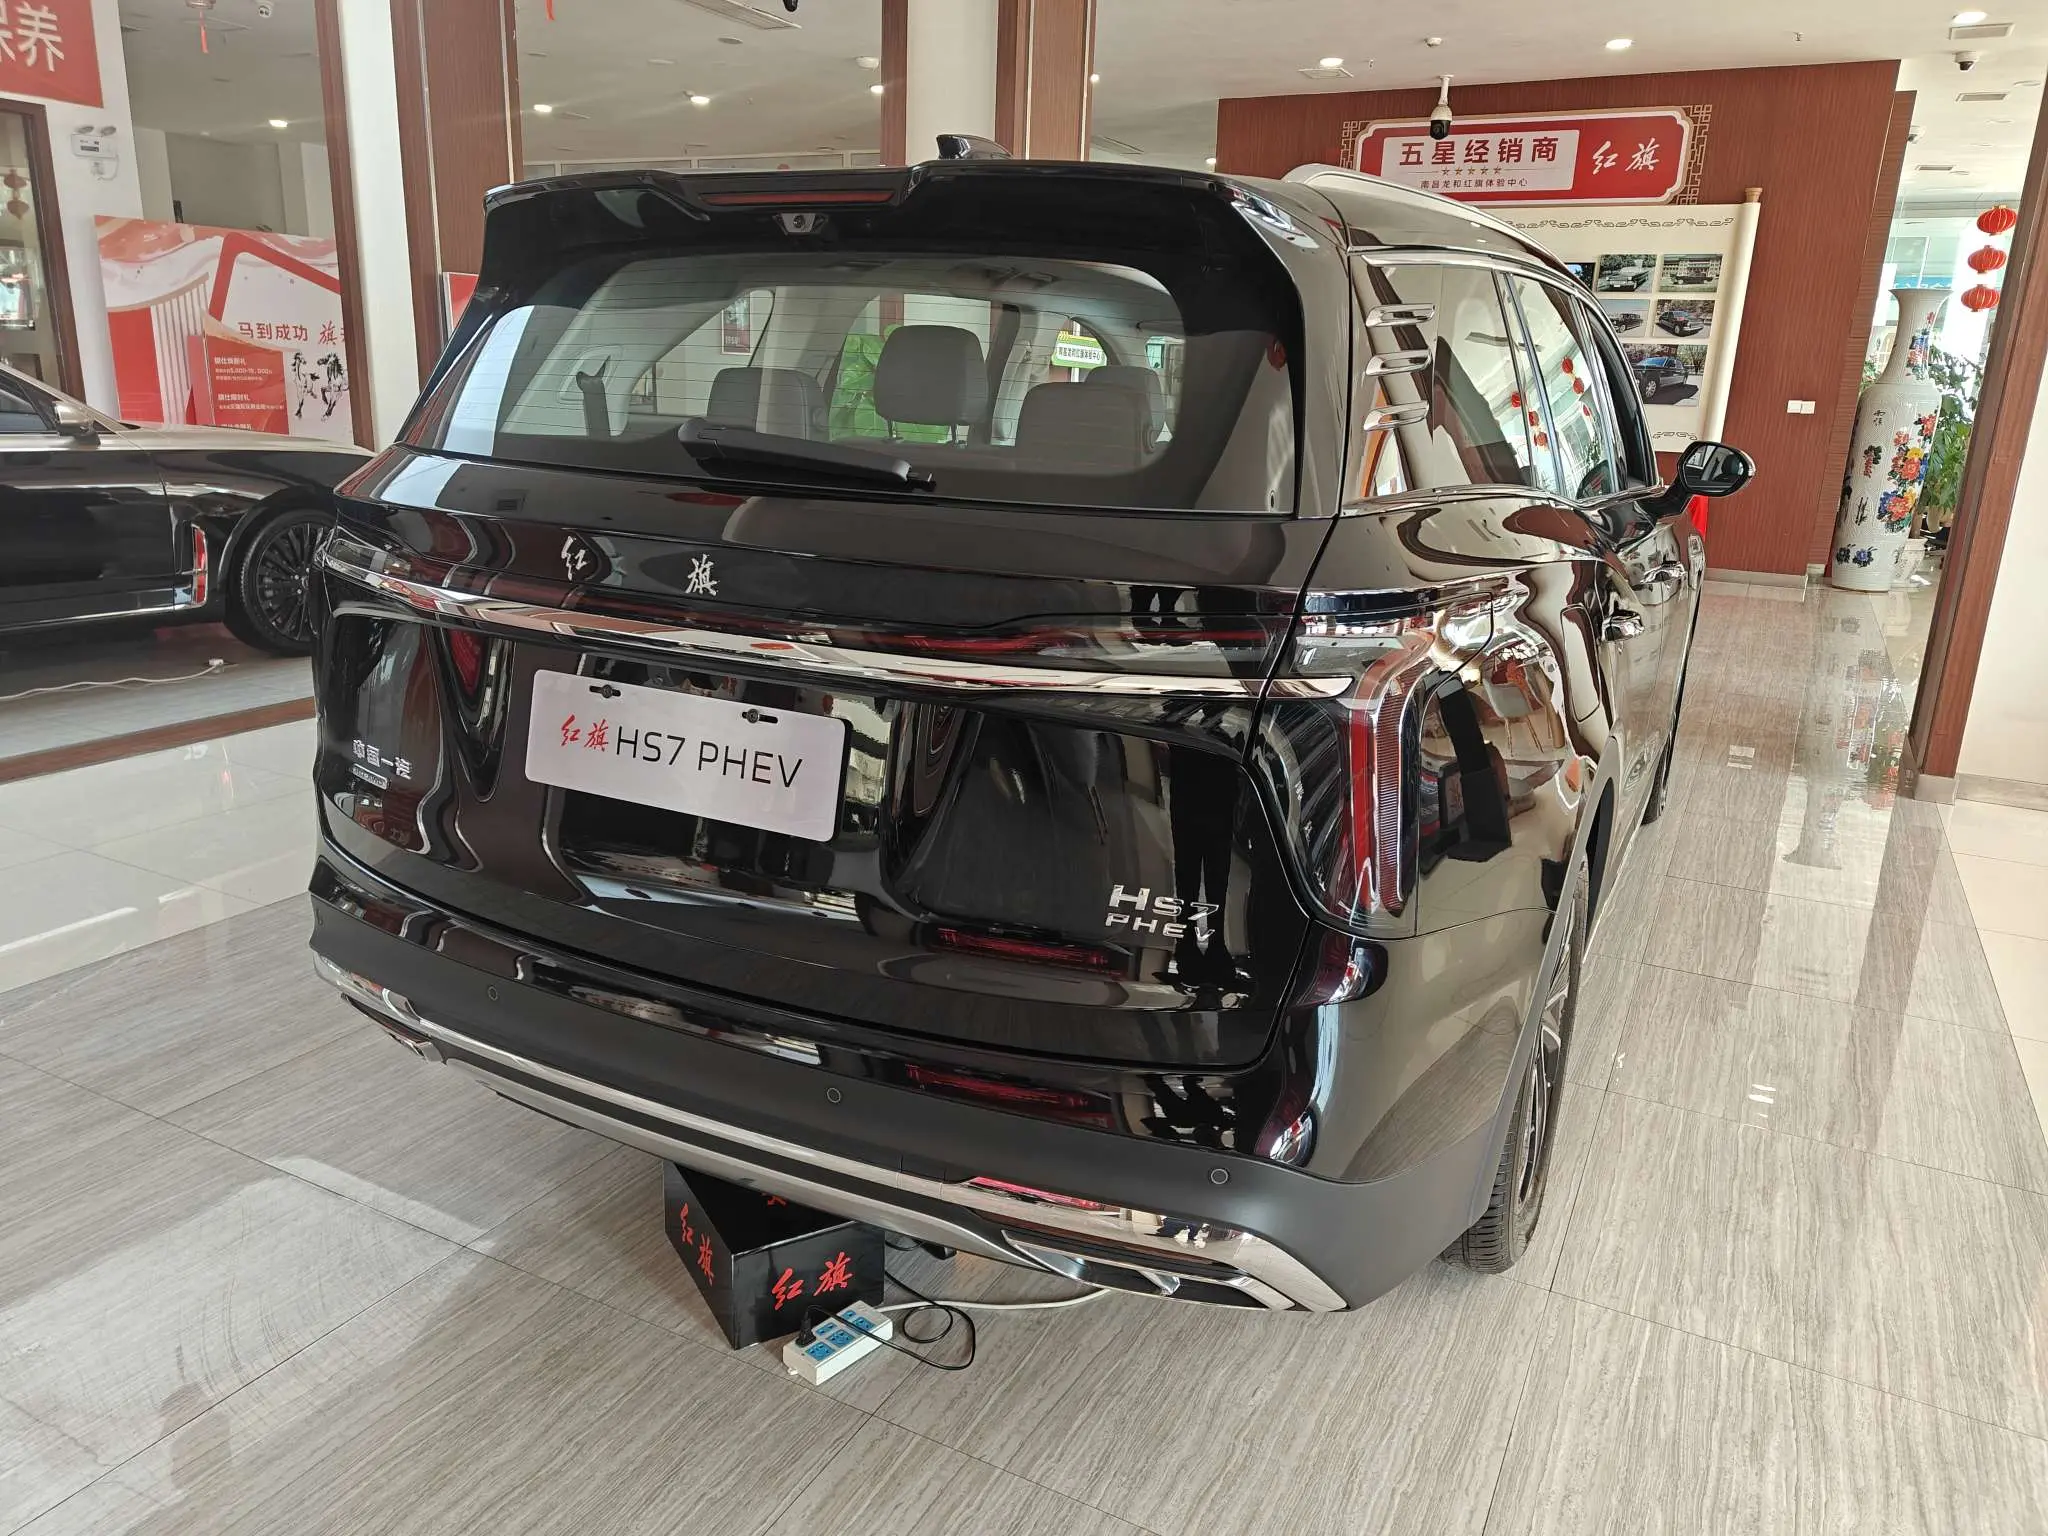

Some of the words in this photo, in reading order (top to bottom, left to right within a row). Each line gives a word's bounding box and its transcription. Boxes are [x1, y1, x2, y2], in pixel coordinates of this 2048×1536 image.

[1399, 136, 1559, 166] 五星经销商
[1592, 138, 1660, 175] 红旗
[238, 321, 308, 342] 马到成功
[318, 320, 345, 345] 旗
[561, 535, 719, 596] 红旗
[560, 714, 609, 752] 红旗
[616, 725, 686, 766] HS7
[697, 741, 803, 788] PHEV
[1109, 884, 1220, 921] HS7
[1105, 912, 1216, 942] PHEV
[679, 1202, 715, 1287] 红旗
[771, 1251, 854, 1310] 红旗
